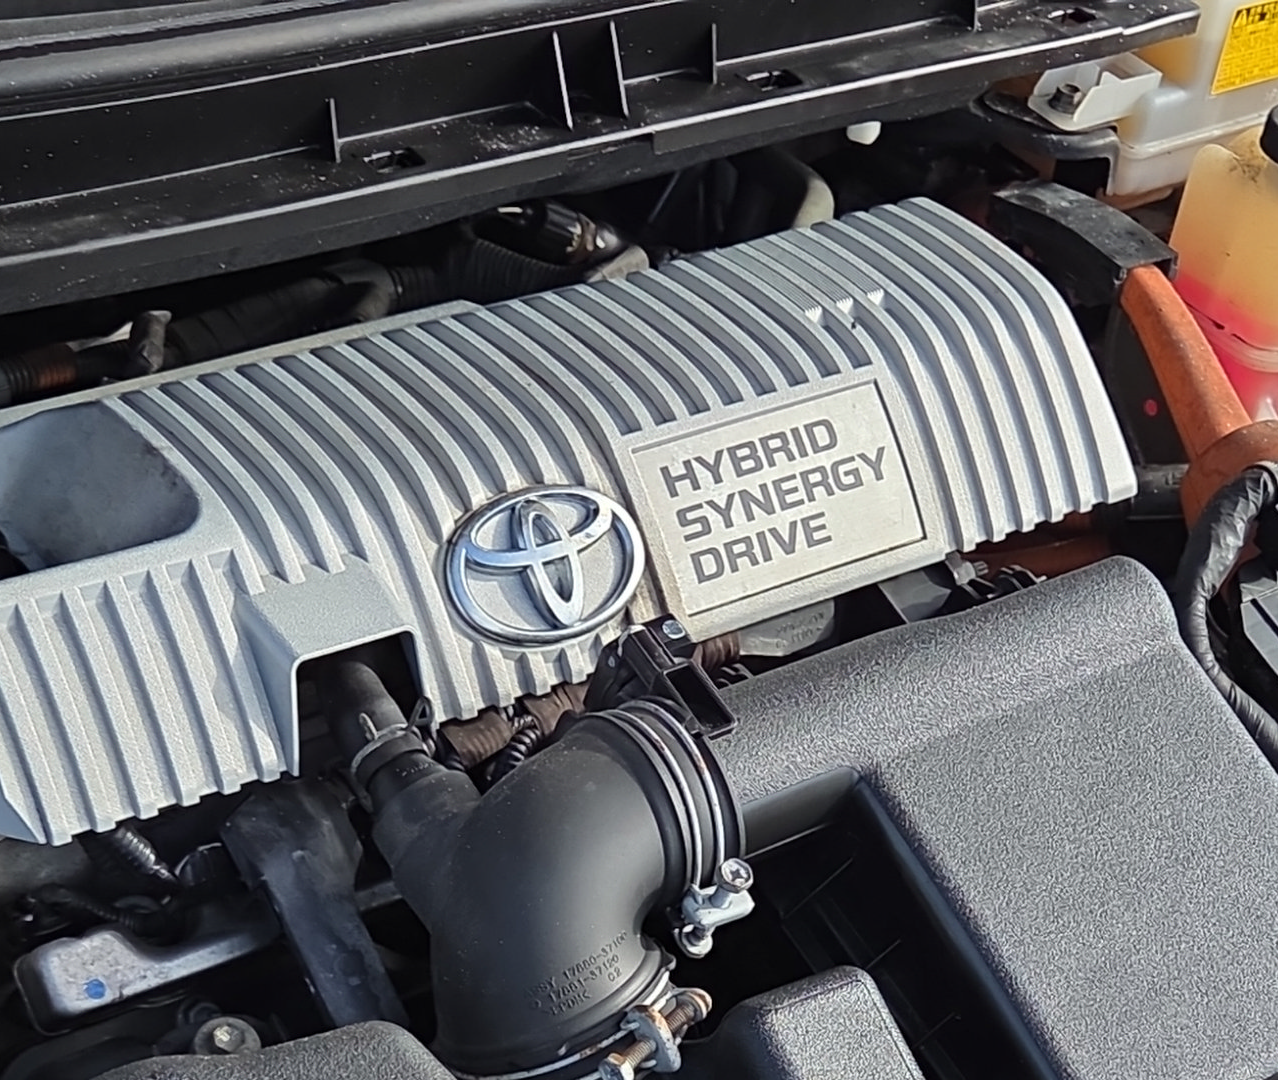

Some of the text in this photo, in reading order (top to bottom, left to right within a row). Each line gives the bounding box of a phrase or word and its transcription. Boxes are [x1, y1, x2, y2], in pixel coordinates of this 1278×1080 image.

[659, 419, 838, 498] HYBRID
[676, 446, 886, 542] SYNERGY
[690, 512, 833, 584] DRIVE
